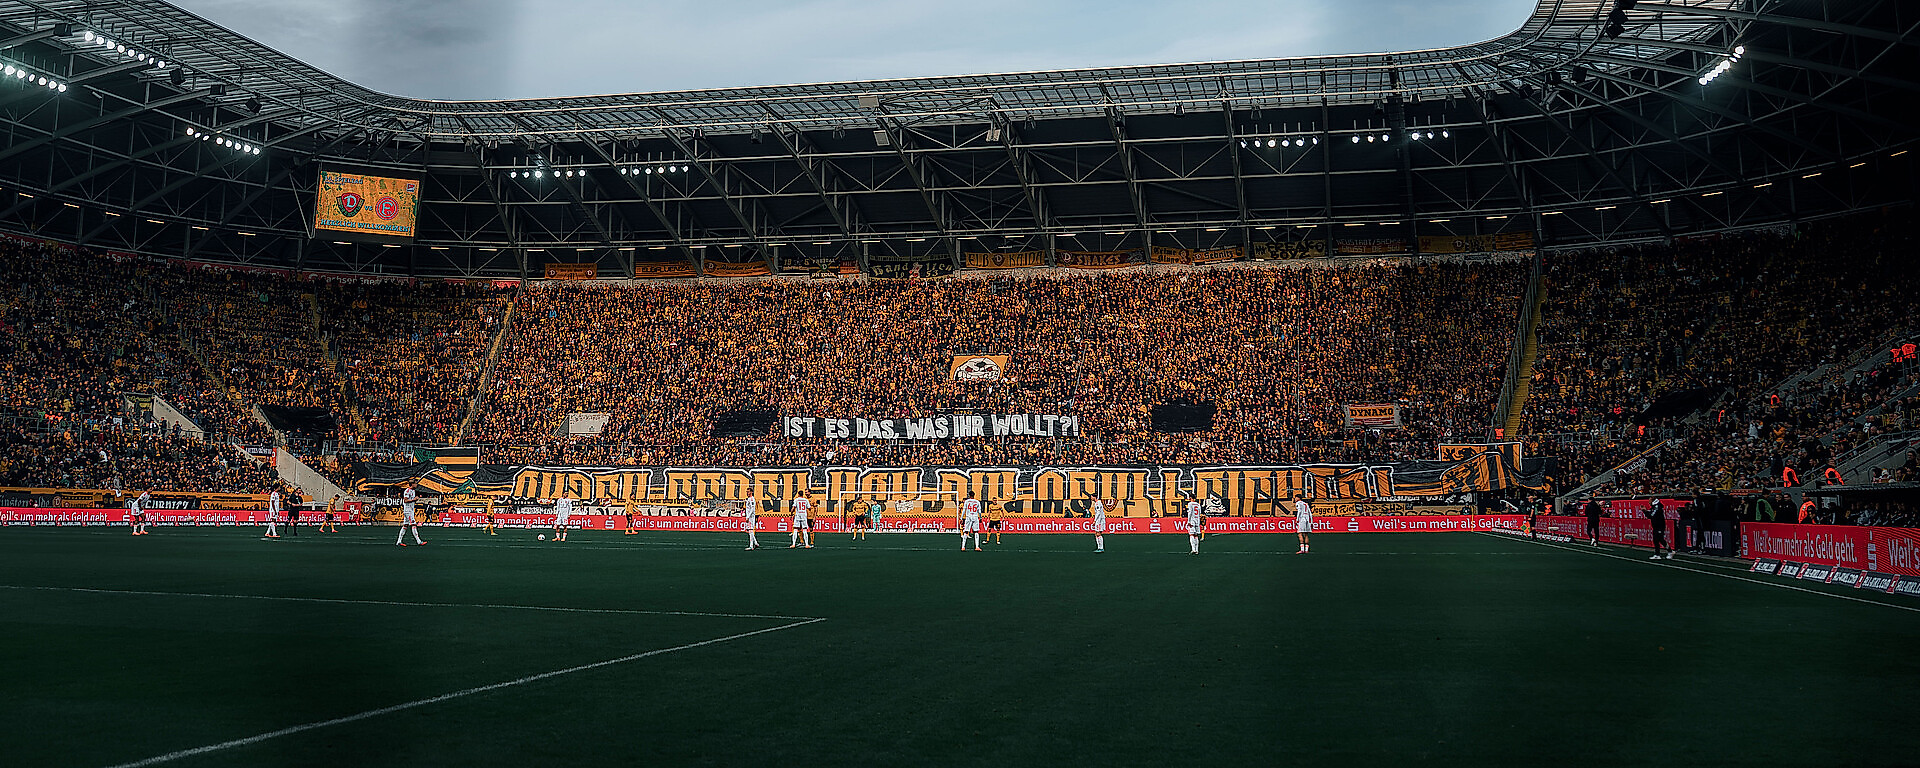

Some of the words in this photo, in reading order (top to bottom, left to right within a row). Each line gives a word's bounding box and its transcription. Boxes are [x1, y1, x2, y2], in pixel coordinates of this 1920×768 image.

[320, 218, 356, 228] HERZLICH
[357, 222, 412, 233] WILLKOMMEN!
[1076, 254, 1121, 266] SNAKES
[1350, 407, 1394, 417] DYNAMO
[784, 416, 815, 437] IST
[824, 418, 850, 439] ES
[856, 417, 900, 439] DAS,
[905, 417, 949, 439] WAS
[953, 414, 985, 437] IHR
[991, 413, 1079, 437] WOLLT?!
[798, 501, 806, 511] 15
[967, 503, 978, 513] 46
[1193, 505, 1199, 516] 5
[0, 511, 19, 521] eil's
[19, 513, 34, 521] um
[35, 511, 57, 521] mehr
[58, 511, 70, 521] als
[71, 511, 89, 521] Geld
[165, 513, 177, 522] um
[196, 512, 205, 522] als
[206, 513, 220, 522] Geld
[462, 515, 489, 524] Weil's
[507, 516, 531, 525] mehr
[531, 516, 545, 525] als
[570, 516, 594, 528] geht.
[656, 520, 671, 529] um
[674, 518, 698, 529] mehr
[699, 518, 715, 529] als
[716, 518, 738, 529] Geld
[895, 519, 918, 530] Geld
[1016, 522, 1033, 531] um
[1036, 520, 1063, 531] mehr
[1064, 520, 1081, 531] als
[1108, 520, 1137, 534] geht.
[1209, 523, 1227, 531] um
[1229, 520, 1259, 531] mehr
[1260, 519, 1276, 530] als
[1312, 519, 1335, 531] eht.
[1372, 519, 1406, 530] Weil's
[1408, 521, 1427, 529] um
[1428, 518, 1459, 529] mehr
[1460, 518, 1477, 529] als
[1478, 517, 1502, 528] Geld
[1753, 530, 1772, 554] Weil's
[1772, 537, 1784, 555] um
[1784, 531, 1803, 557] mehr
[1803, 532, 1815, 558] als
[1815, 533, 1834, 560] Geld
[1835, 535, 1858, 567] geht.
